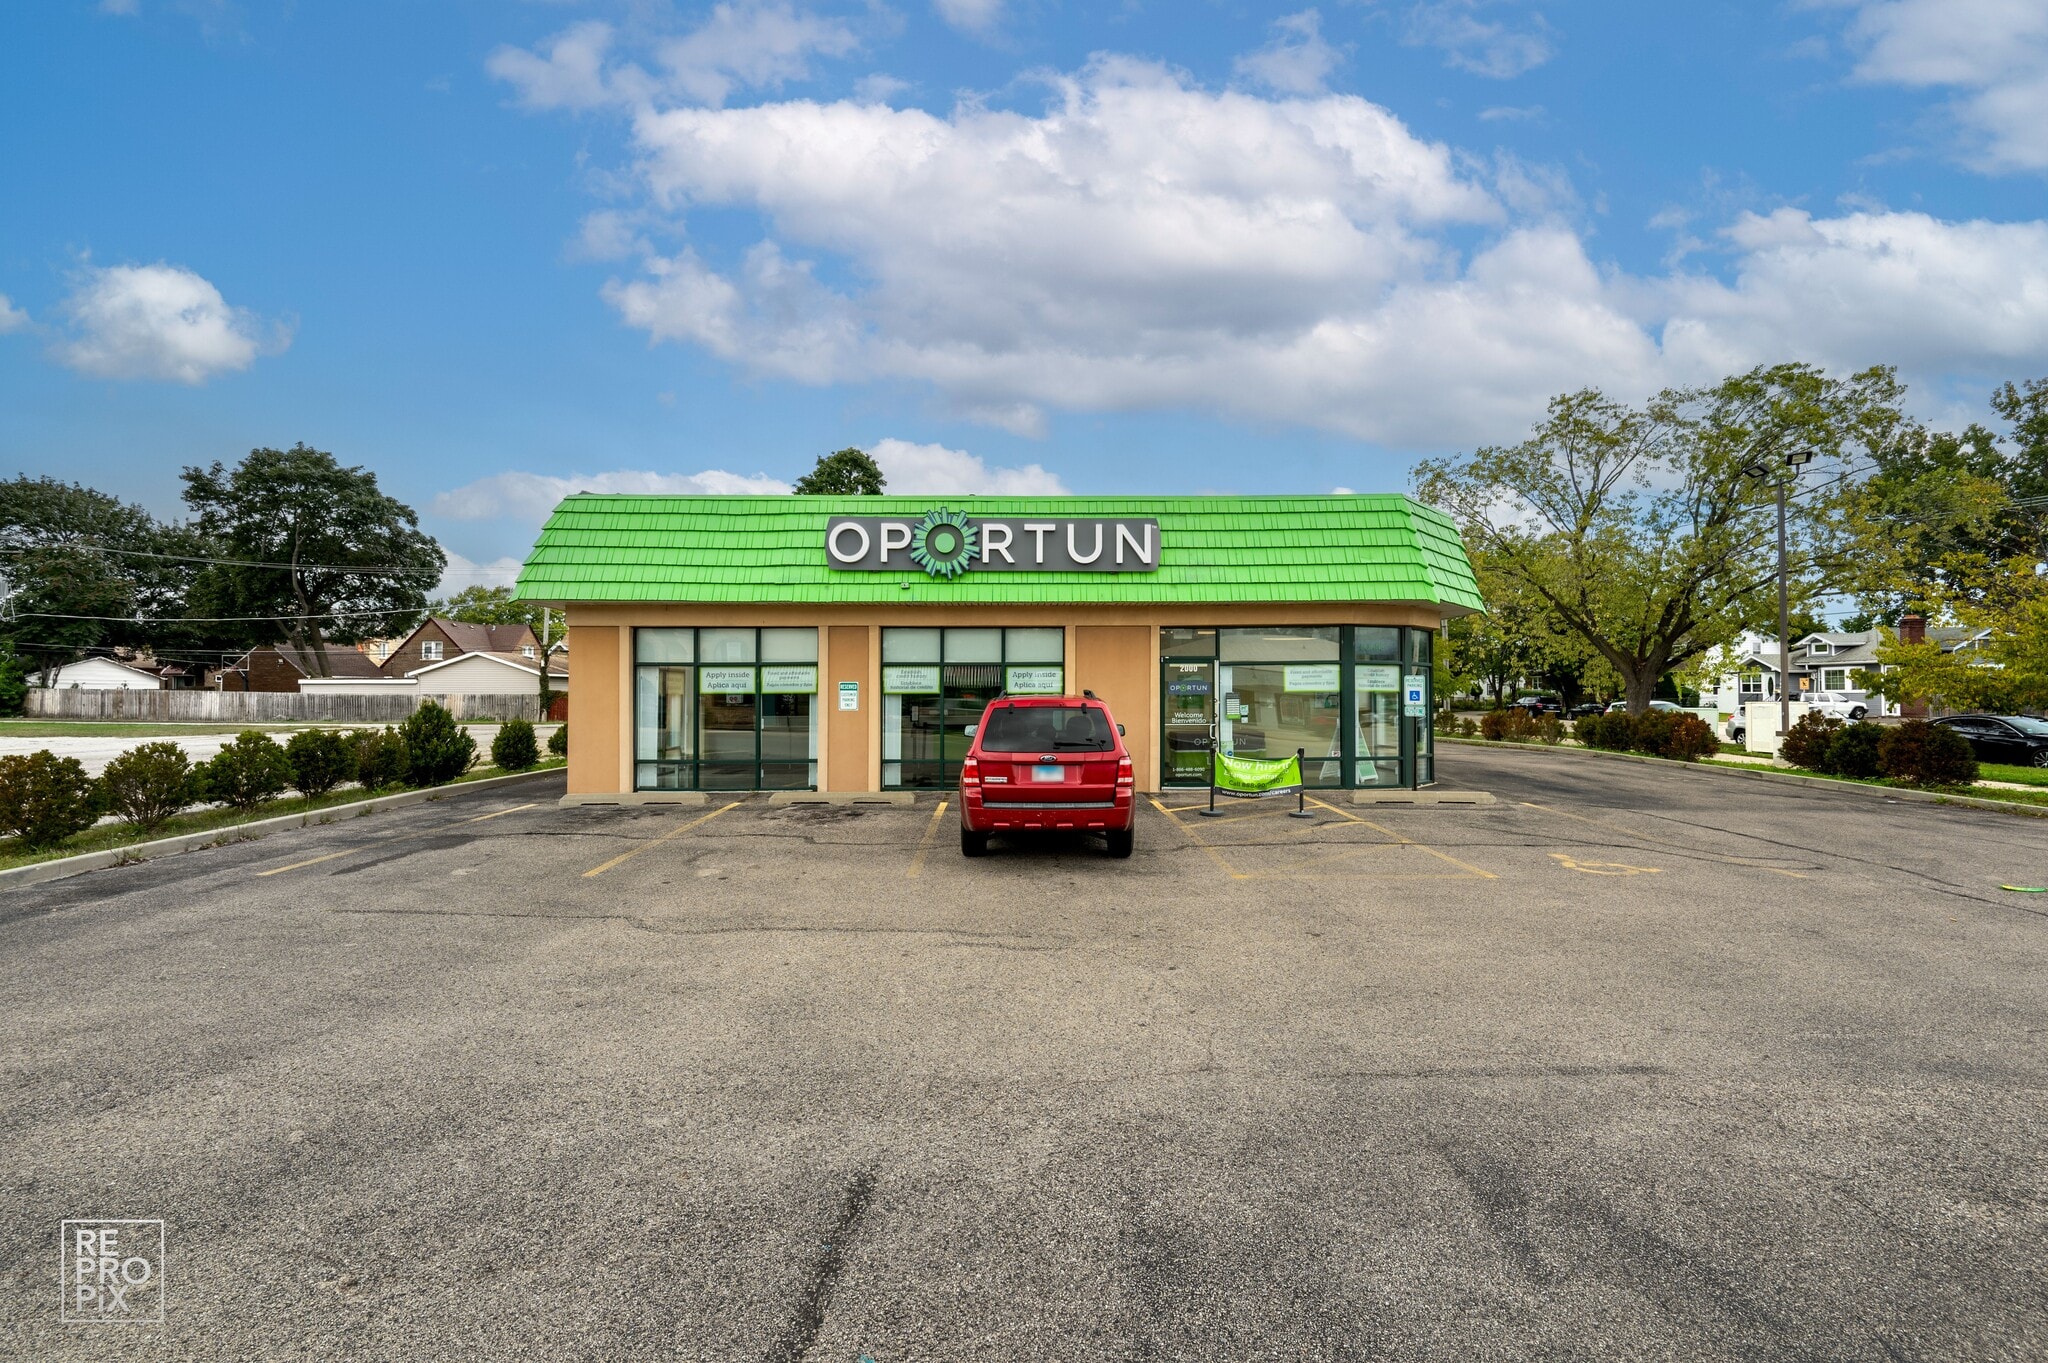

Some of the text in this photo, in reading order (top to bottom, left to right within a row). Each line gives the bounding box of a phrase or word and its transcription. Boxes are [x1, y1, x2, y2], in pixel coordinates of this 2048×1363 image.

[828, 513, 1152, 573] OPORTUN
[1180, 665, 1198, 673] 2000
[705, 672, 727, 680] Apply
[1012, 672, 1034, 680] Apply
[707, 682, 730, 690] Aplica
[1014, 682, 1036, 690] Aplica
[1170, 684, 1208, 692] OPORTUN
[1224, 757, 1252, 770] Now
[1221, 788, 1292, 799] www.oportun.com/careers
